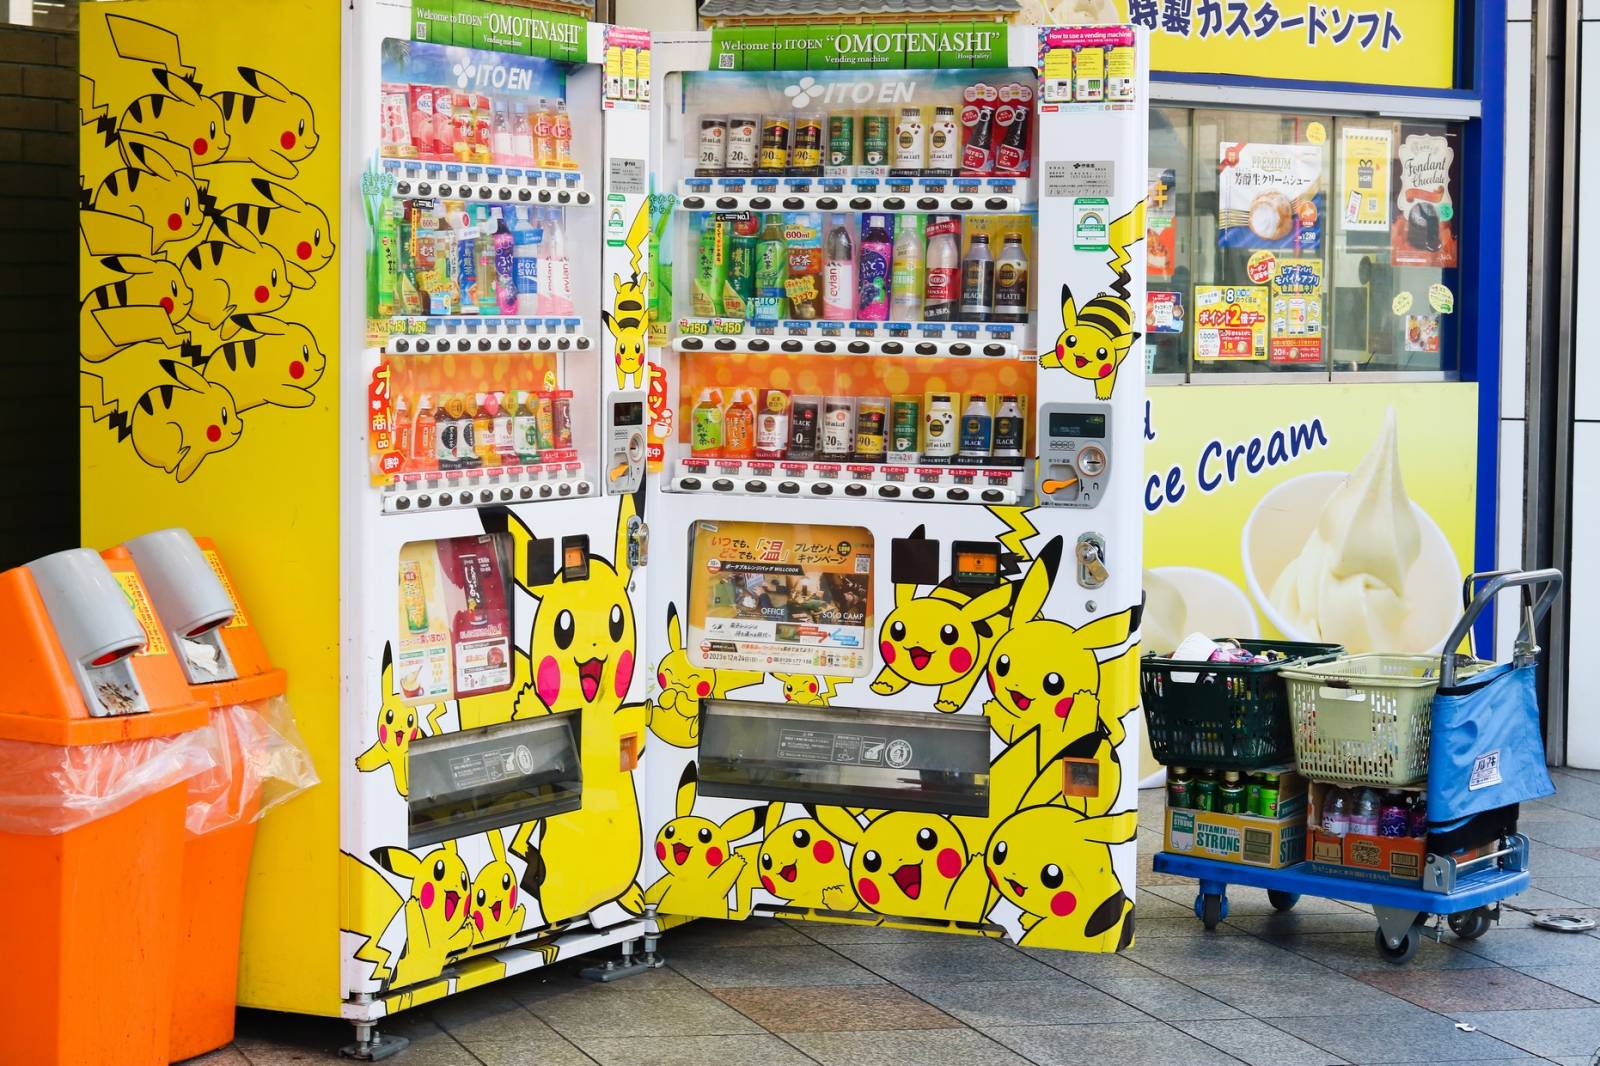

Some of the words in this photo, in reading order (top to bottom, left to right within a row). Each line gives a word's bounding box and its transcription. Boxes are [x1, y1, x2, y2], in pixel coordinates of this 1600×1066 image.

[416, 7, 449, 22] Welcome
[450, 14, 457, 23] to
[458, 13, 482, 26] ITOEN
[1128, 0, 1402, 49] 特製カスタードソフト
[720, 40, 769, 51] Welcome
[771, 42, 783, 50] to
[784, 39, 822, 50] ITOEN
[824, 55, 855, 64] Vending
[856, 55, 889, 63] machine
[475, 63, 506, 88] ITO
[508, 68, 533, 90] EN
[824, 82, 873, 104] ITO
[877, 81, 916, 103] EN
[1252, 159, 1291, 170] PREMIUM
[1404, 153, 1447, 177] Fondant
[829, 268, 838, 297] evian
[1225, 287, 1235, 304] 8
[1199, 303, 1266, 328] ポイント2倍デー
[651, 324, 667, 335] No.1
[372, 413, 390, 449] 商品
[1144, 466, 1186, 512] ce
[1198, 418, 1329, 492] Cream
[794, 542, 834, 554] プレゼント
[797, 553, 848, 565] キャンペーン
[761, 607, 785, 616] OFFICE
[822, 611, 842, 620] SOLO
[843, 612, 864, 620] CAMP
[1173, 817, 1193, 828] STRONG
[1197, 823, 1228, 835] VITAMIN
[1196, 832, 1241, 853] STRONG
